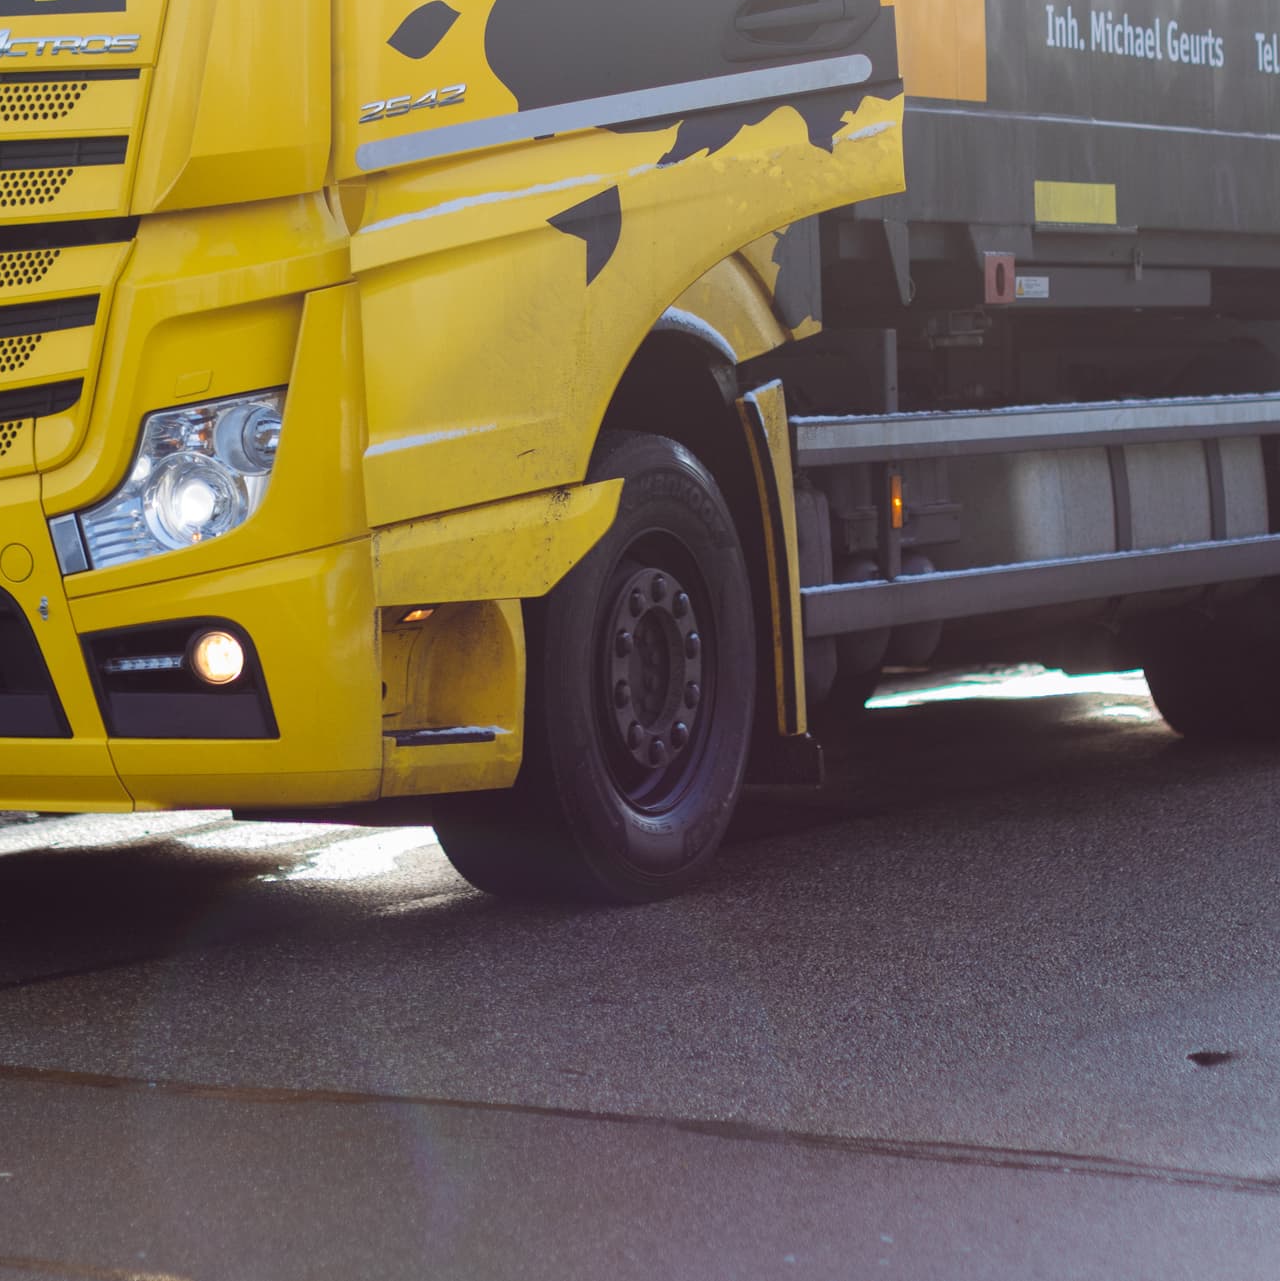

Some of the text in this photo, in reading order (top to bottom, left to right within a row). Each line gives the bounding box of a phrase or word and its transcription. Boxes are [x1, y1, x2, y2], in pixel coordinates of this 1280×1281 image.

[1046, 4, 1085, 51] Inh.
[1091, 10, 1162, 60] Michael
[1167, 20, 1224, 67] Geurts
[359, 83, 467, 123] 2542
